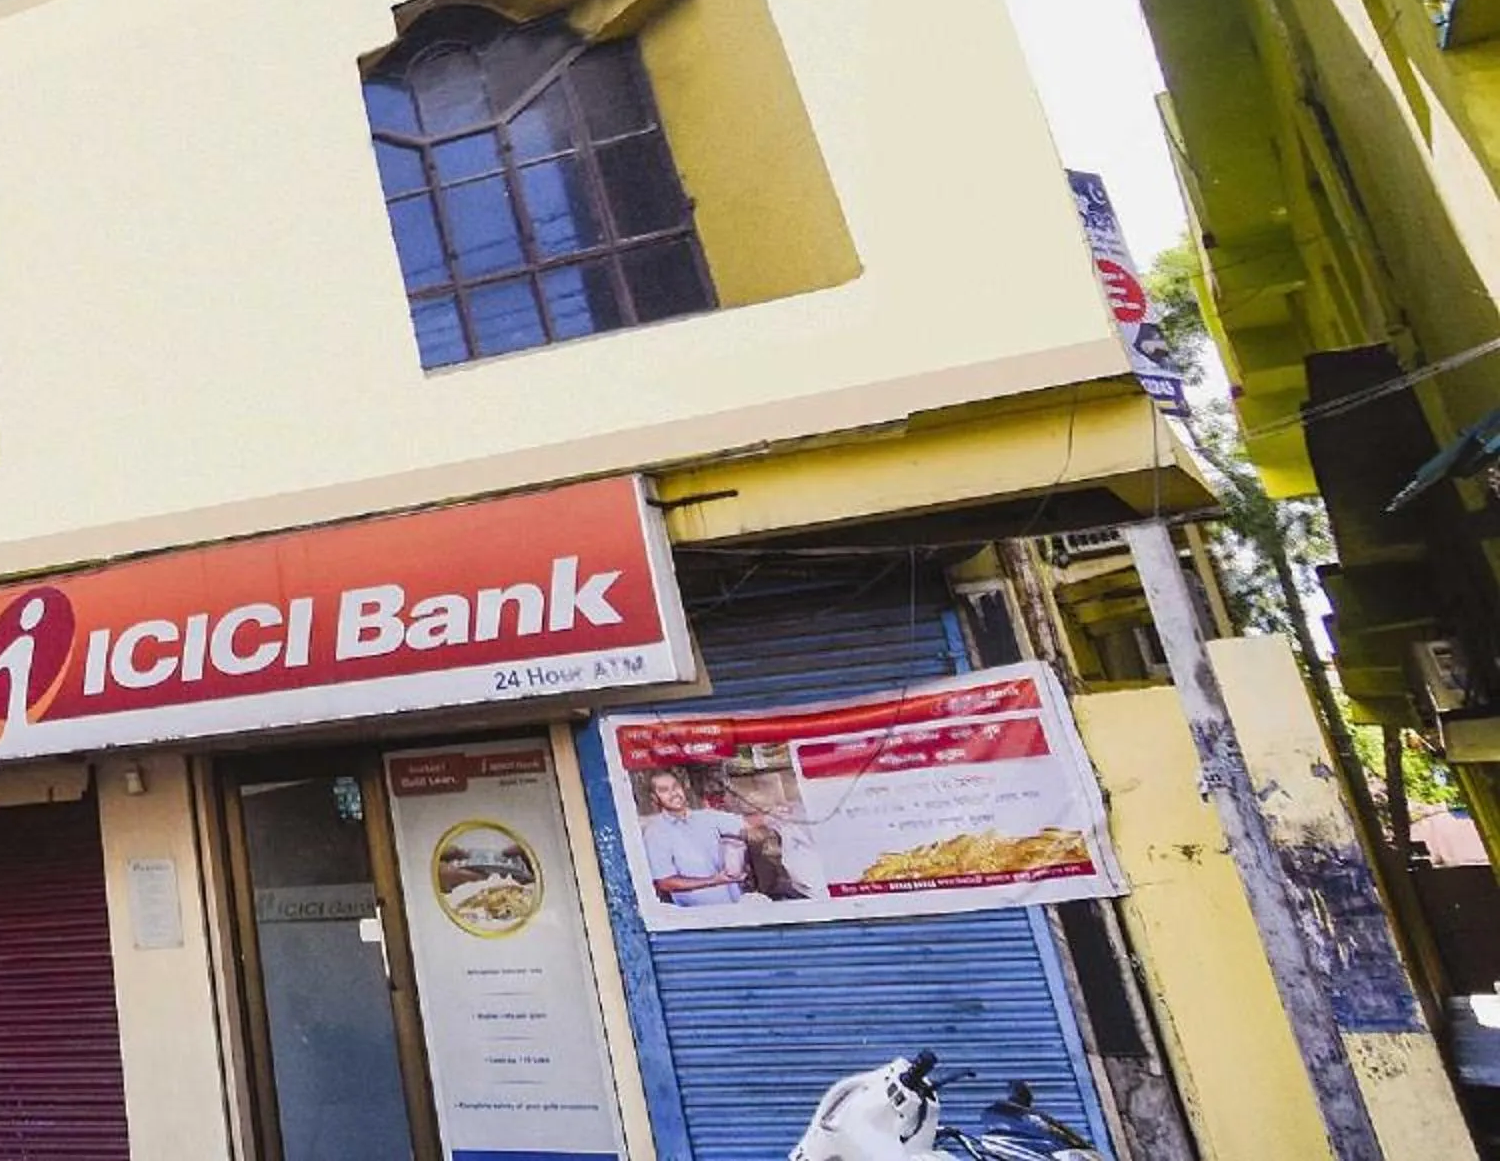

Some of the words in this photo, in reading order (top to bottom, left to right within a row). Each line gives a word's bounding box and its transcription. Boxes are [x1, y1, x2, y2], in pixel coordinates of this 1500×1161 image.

[81, 597, 315, 696] ICICI
[335, 555, 624, 660] Bank
[493, 670, 521, 690] 24
